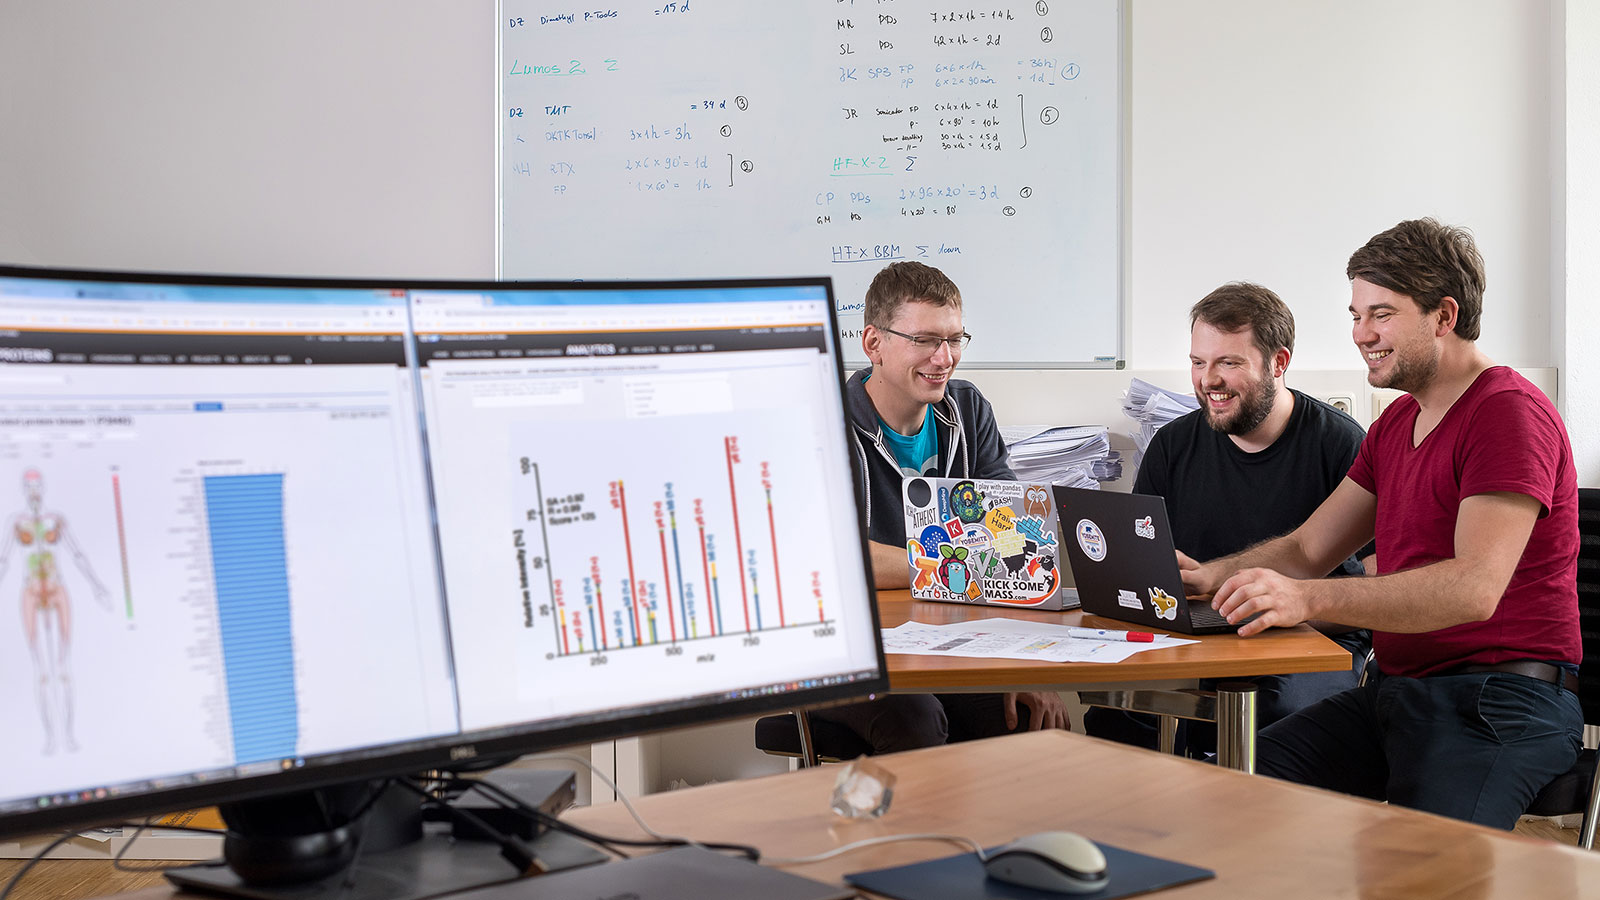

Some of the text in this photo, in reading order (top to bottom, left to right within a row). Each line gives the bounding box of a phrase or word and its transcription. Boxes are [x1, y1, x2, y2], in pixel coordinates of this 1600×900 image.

[509, 59, 561, 75] Lumos
[993, 495, 1013, 507] BASH
[913, 507, 937, 529] ATHEIST
[994, 508, 1013, 525] Trai
[950, 522, 960, 536] K
[961, 535, 988, 546] YOSEMITE
[984, 580, 1045, 592] KICK SOME
